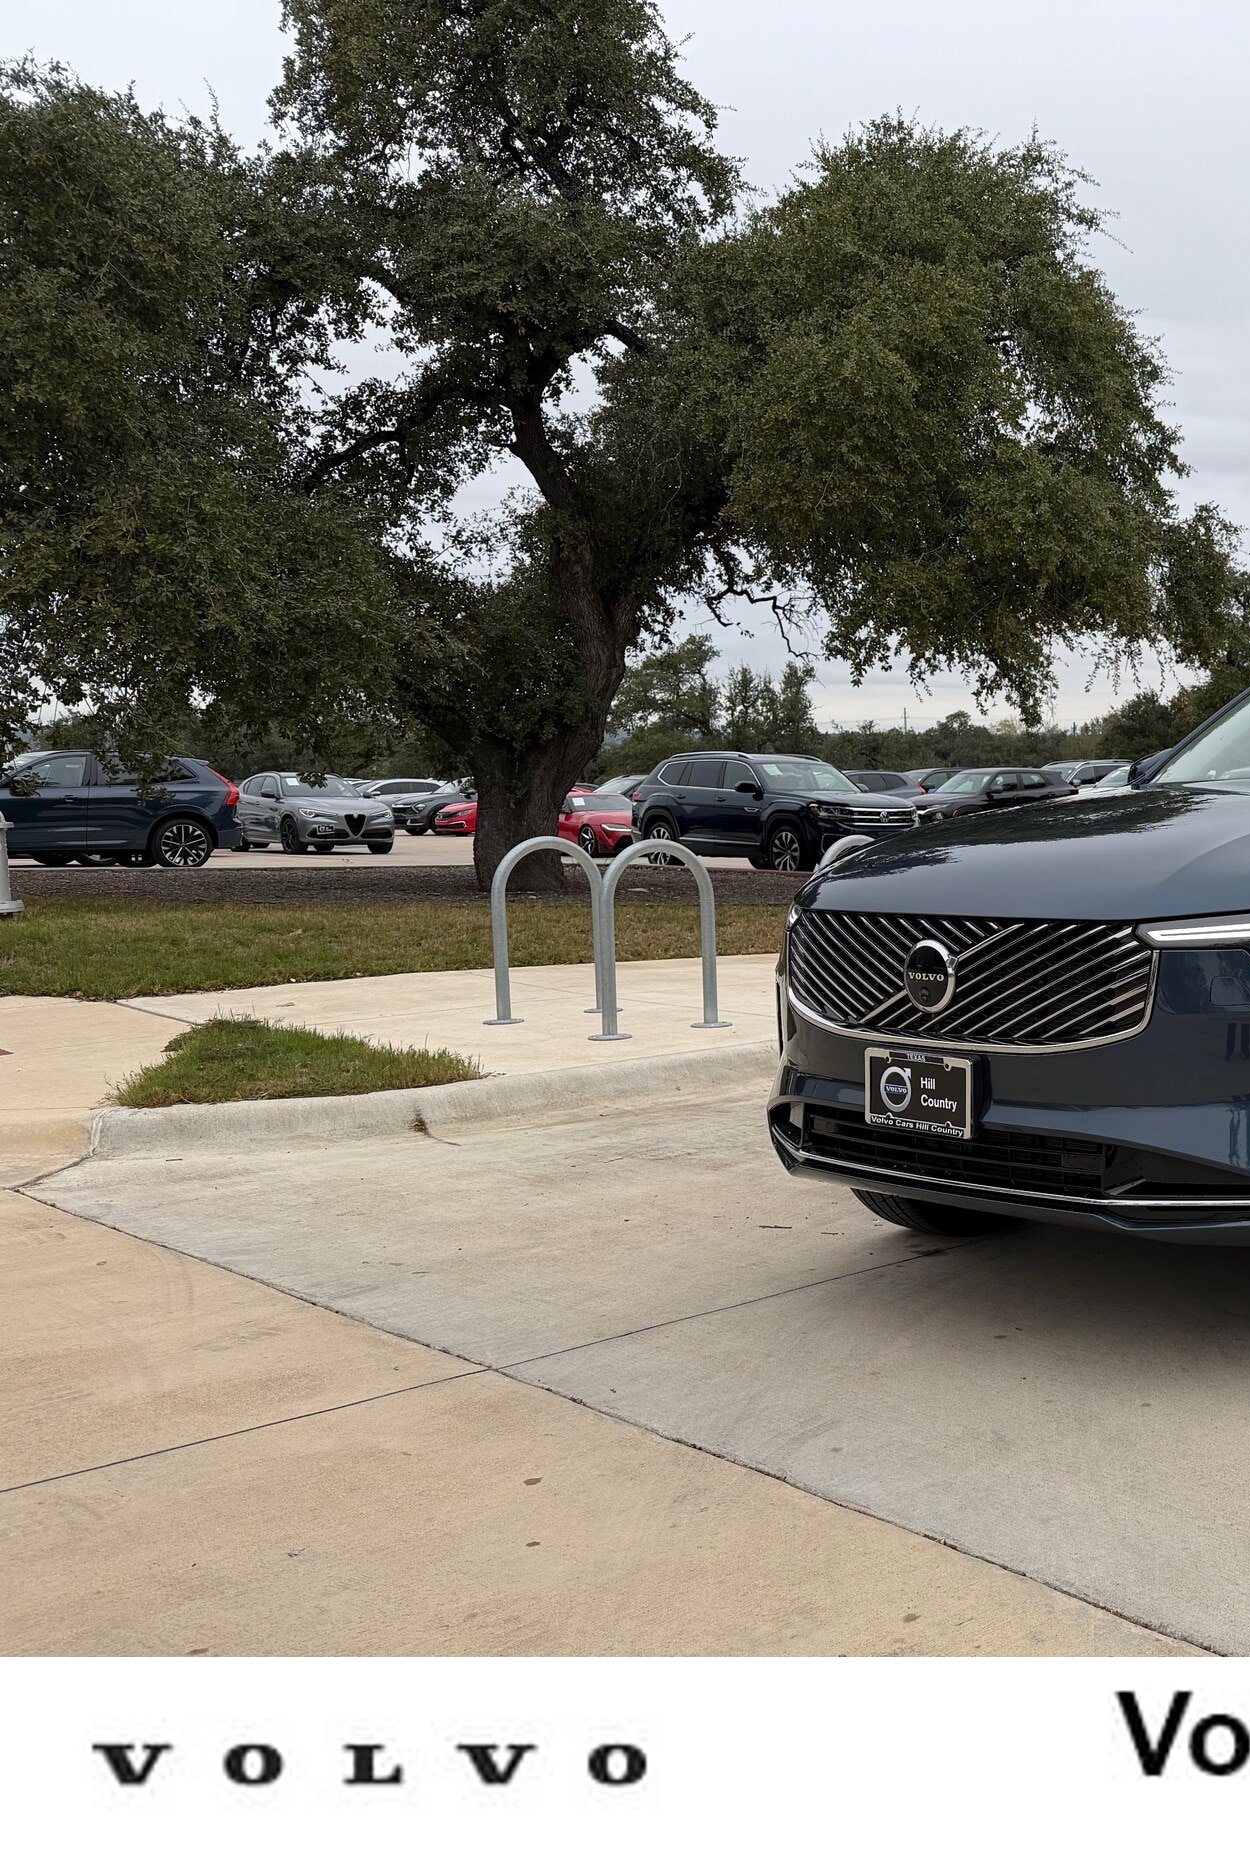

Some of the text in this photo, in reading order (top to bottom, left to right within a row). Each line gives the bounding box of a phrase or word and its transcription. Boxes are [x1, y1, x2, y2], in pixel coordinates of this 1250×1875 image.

[908, 972, 944, 981] VOLVO
[907, 1053, 925, 1061] TEXAS
[885, 1085, 908, 1093] VOLVO
[920, 1077, 936, 1090] Hill
[920, 1094, 957, 1112] Country
[871, 1115, 964, 1137] Volvo Cars Hill Country
